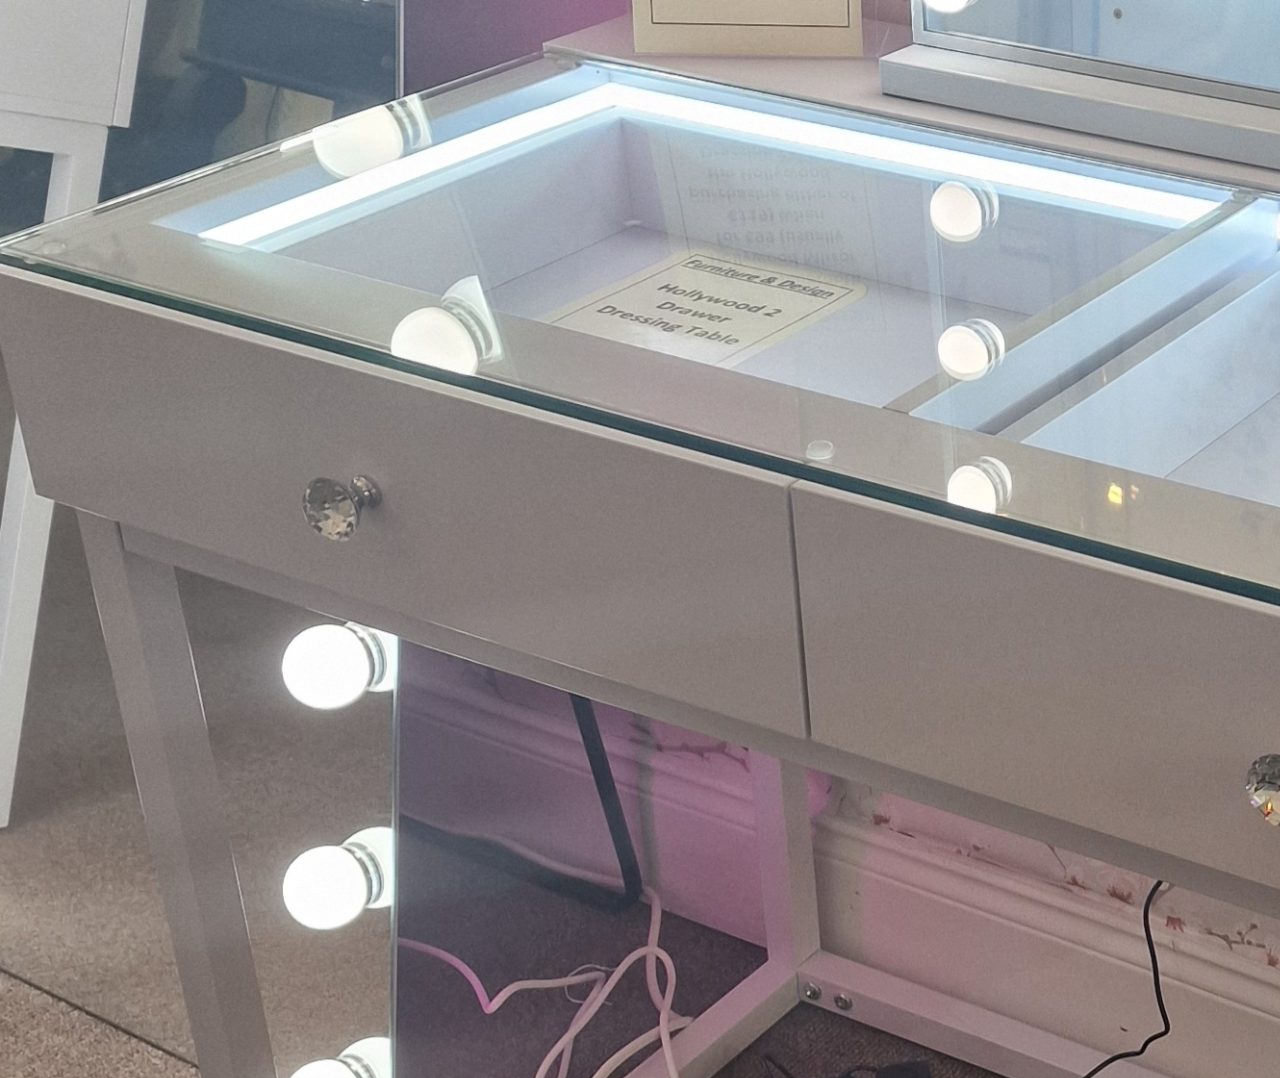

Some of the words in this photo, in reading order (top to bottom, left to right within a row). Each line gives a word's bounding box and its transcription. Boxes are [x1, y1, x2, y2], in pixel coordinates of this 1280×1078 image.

[683, 258, 761, 283] Furniture
[777, 278, 836, 298] Design
[656, 301, 732, 324] Drawer
[658, 283, 765, 313] Hollywood
[764, 308, 783, 319] 2
[596, 304, 681, 334] Dressing
[687, 325, 740, 346] Table
